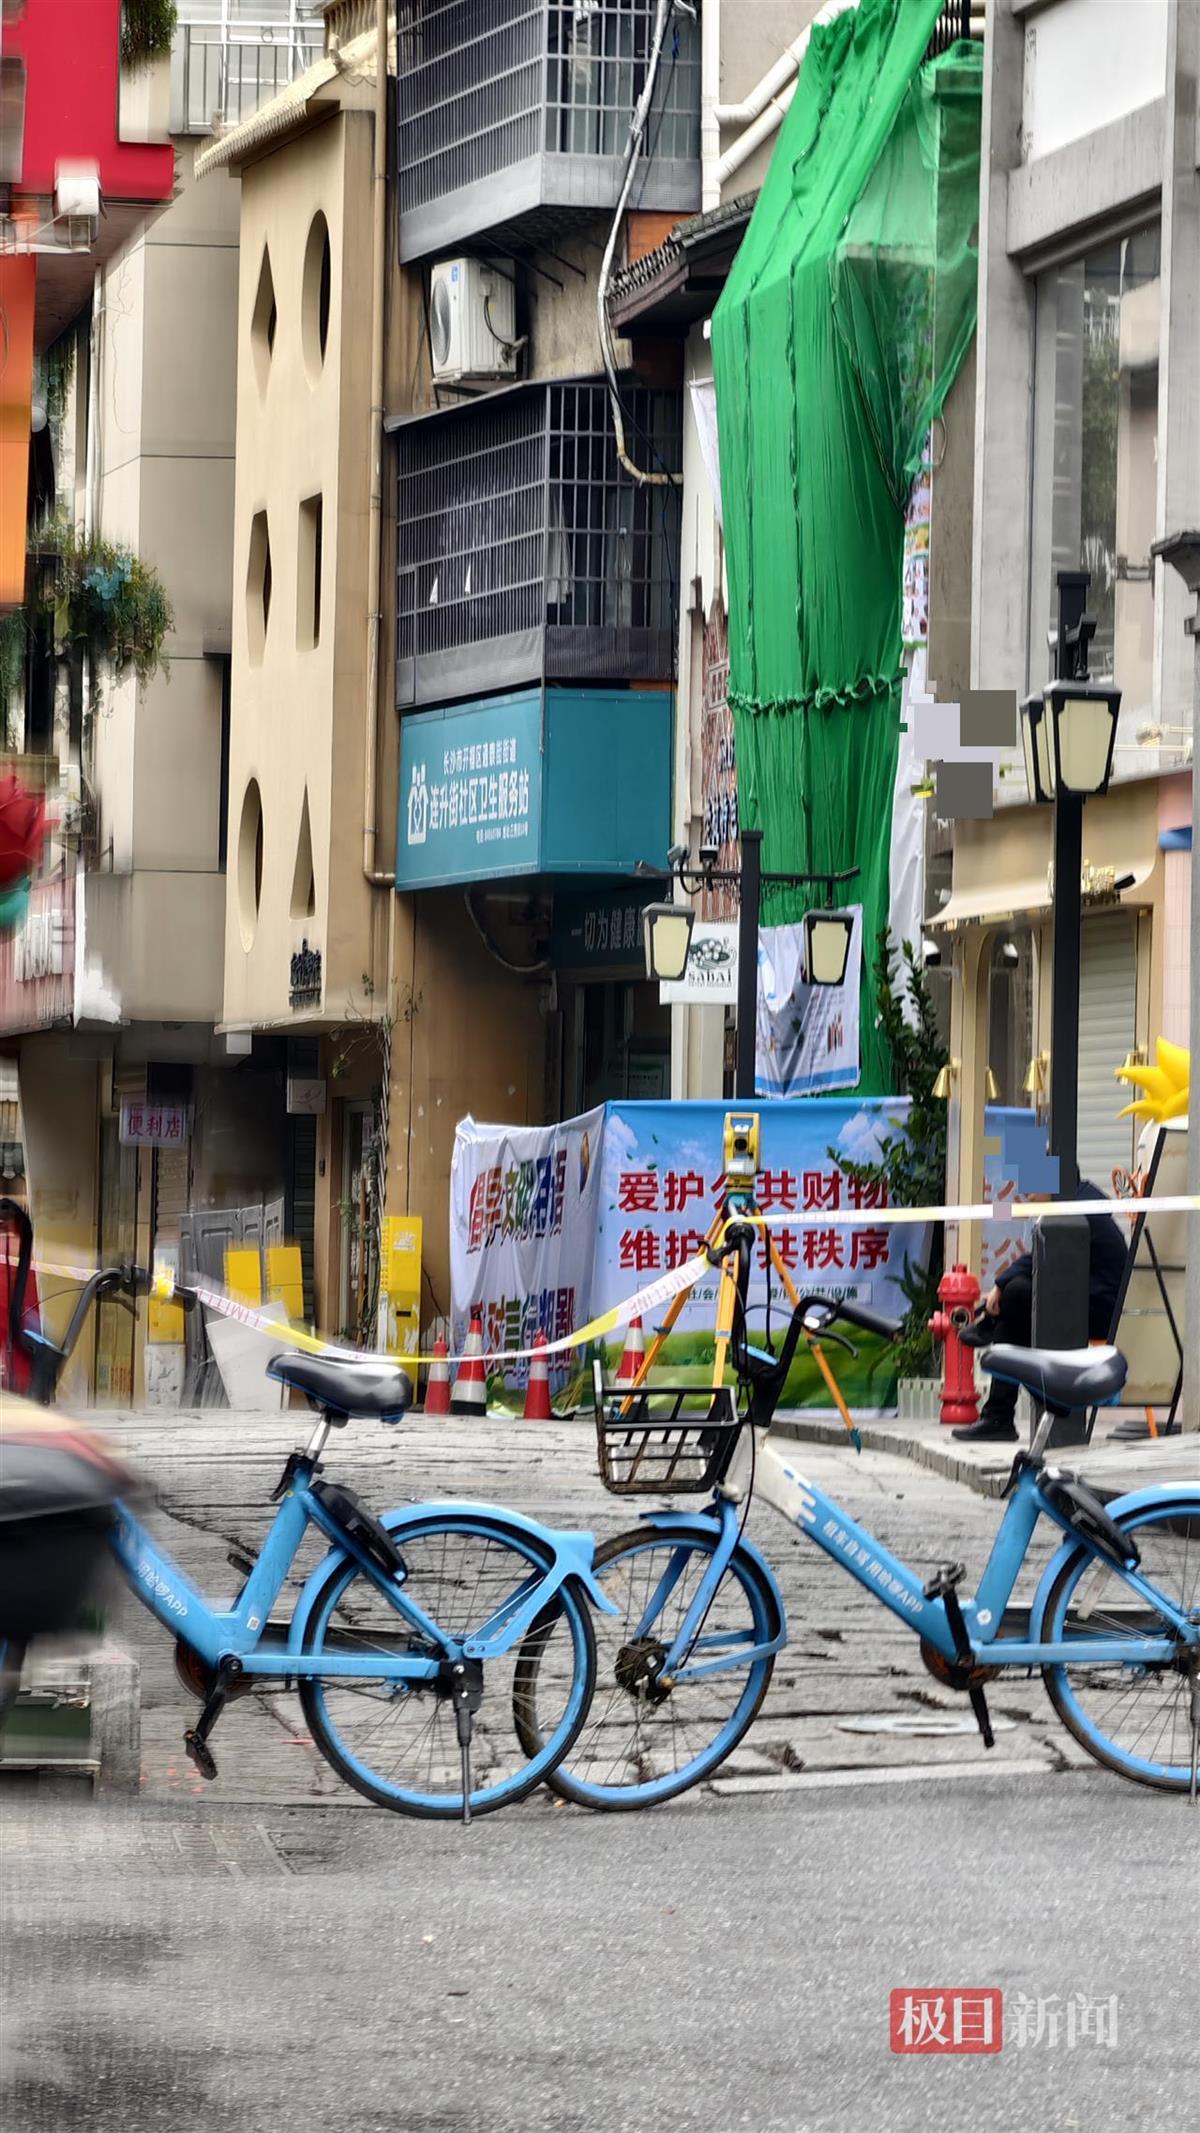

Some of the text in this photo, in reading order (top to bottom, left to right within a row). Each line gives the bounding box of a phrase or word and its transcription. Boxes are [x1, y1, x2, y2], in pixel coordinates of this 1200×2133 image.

[429, 767, 529, 830] 连升街社区卫生服务站
[571, 905, 644, 952] 一切为健康
[128, 1113, 180, 1138] 便利店
[619, 1228, 890, 1272] 维护共秩序
